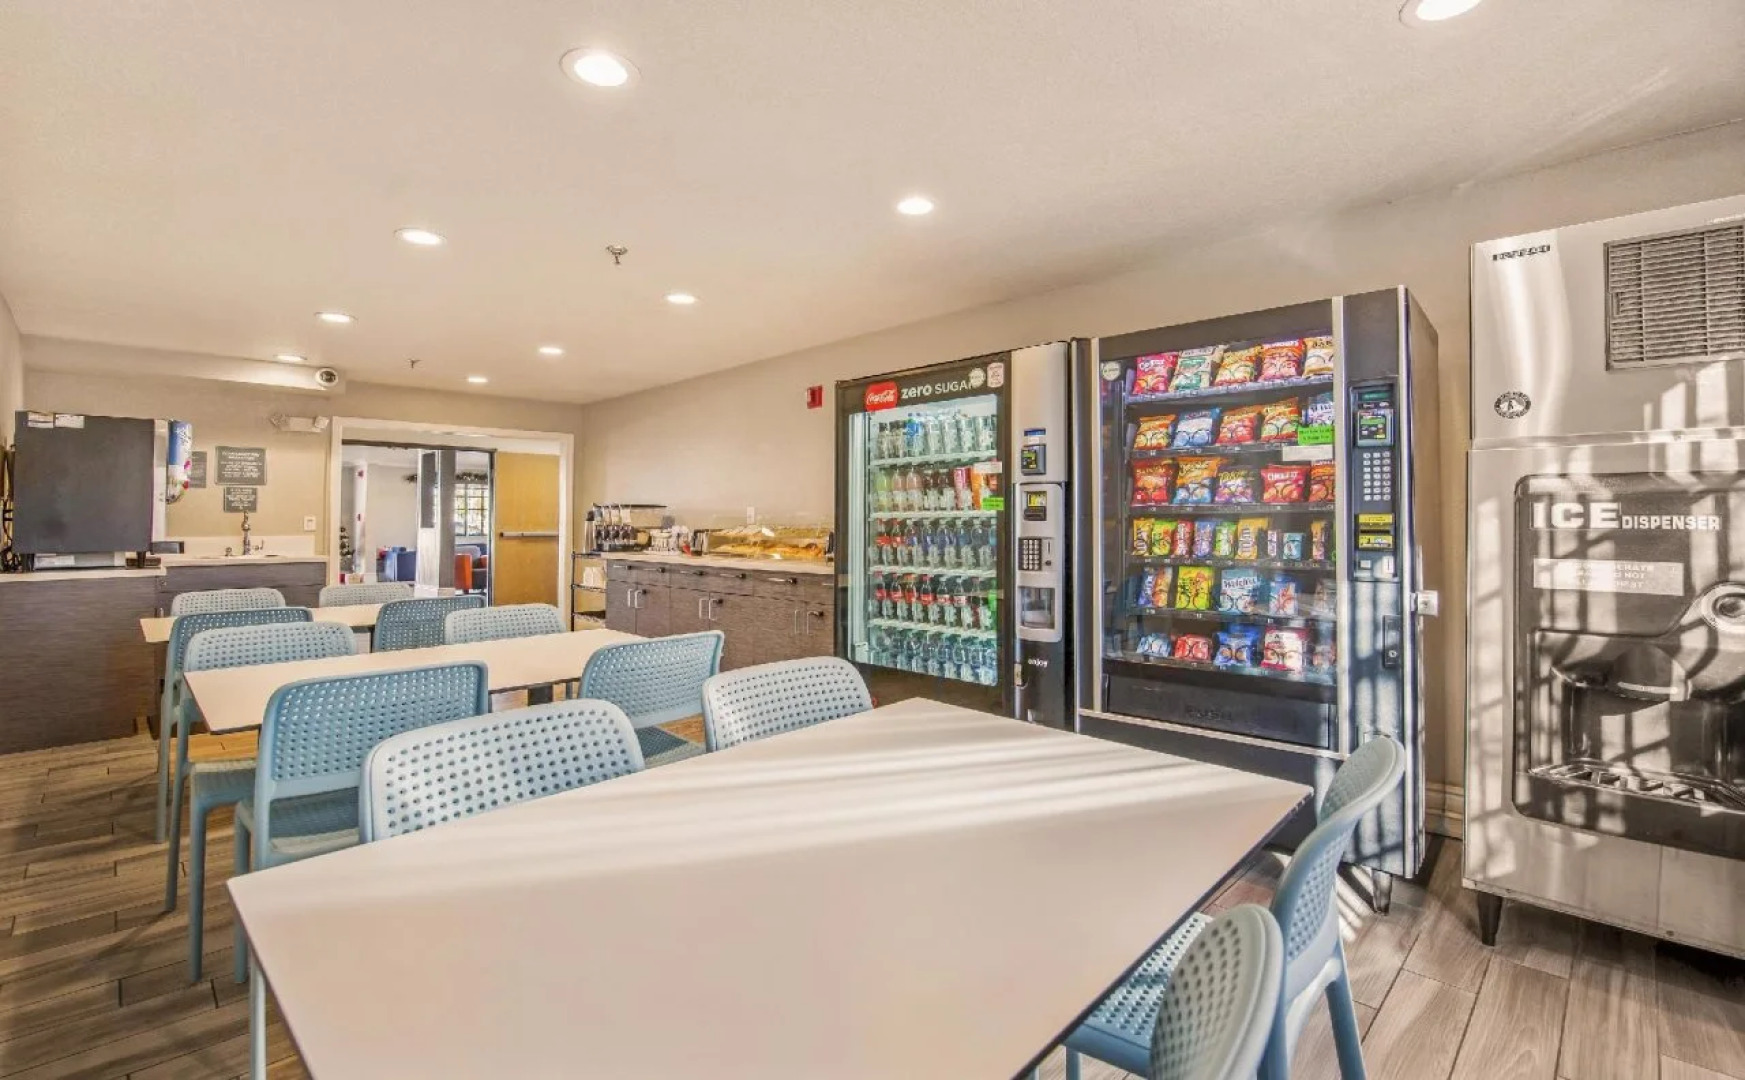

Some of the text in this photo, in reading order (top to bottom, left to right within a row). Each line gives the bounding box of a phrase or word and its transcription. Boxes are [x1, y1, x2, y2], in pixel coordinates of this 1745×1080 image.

[901, 384, 932, 399] zero
[1533, 502, 1721, 530] ICE DISPENSER
